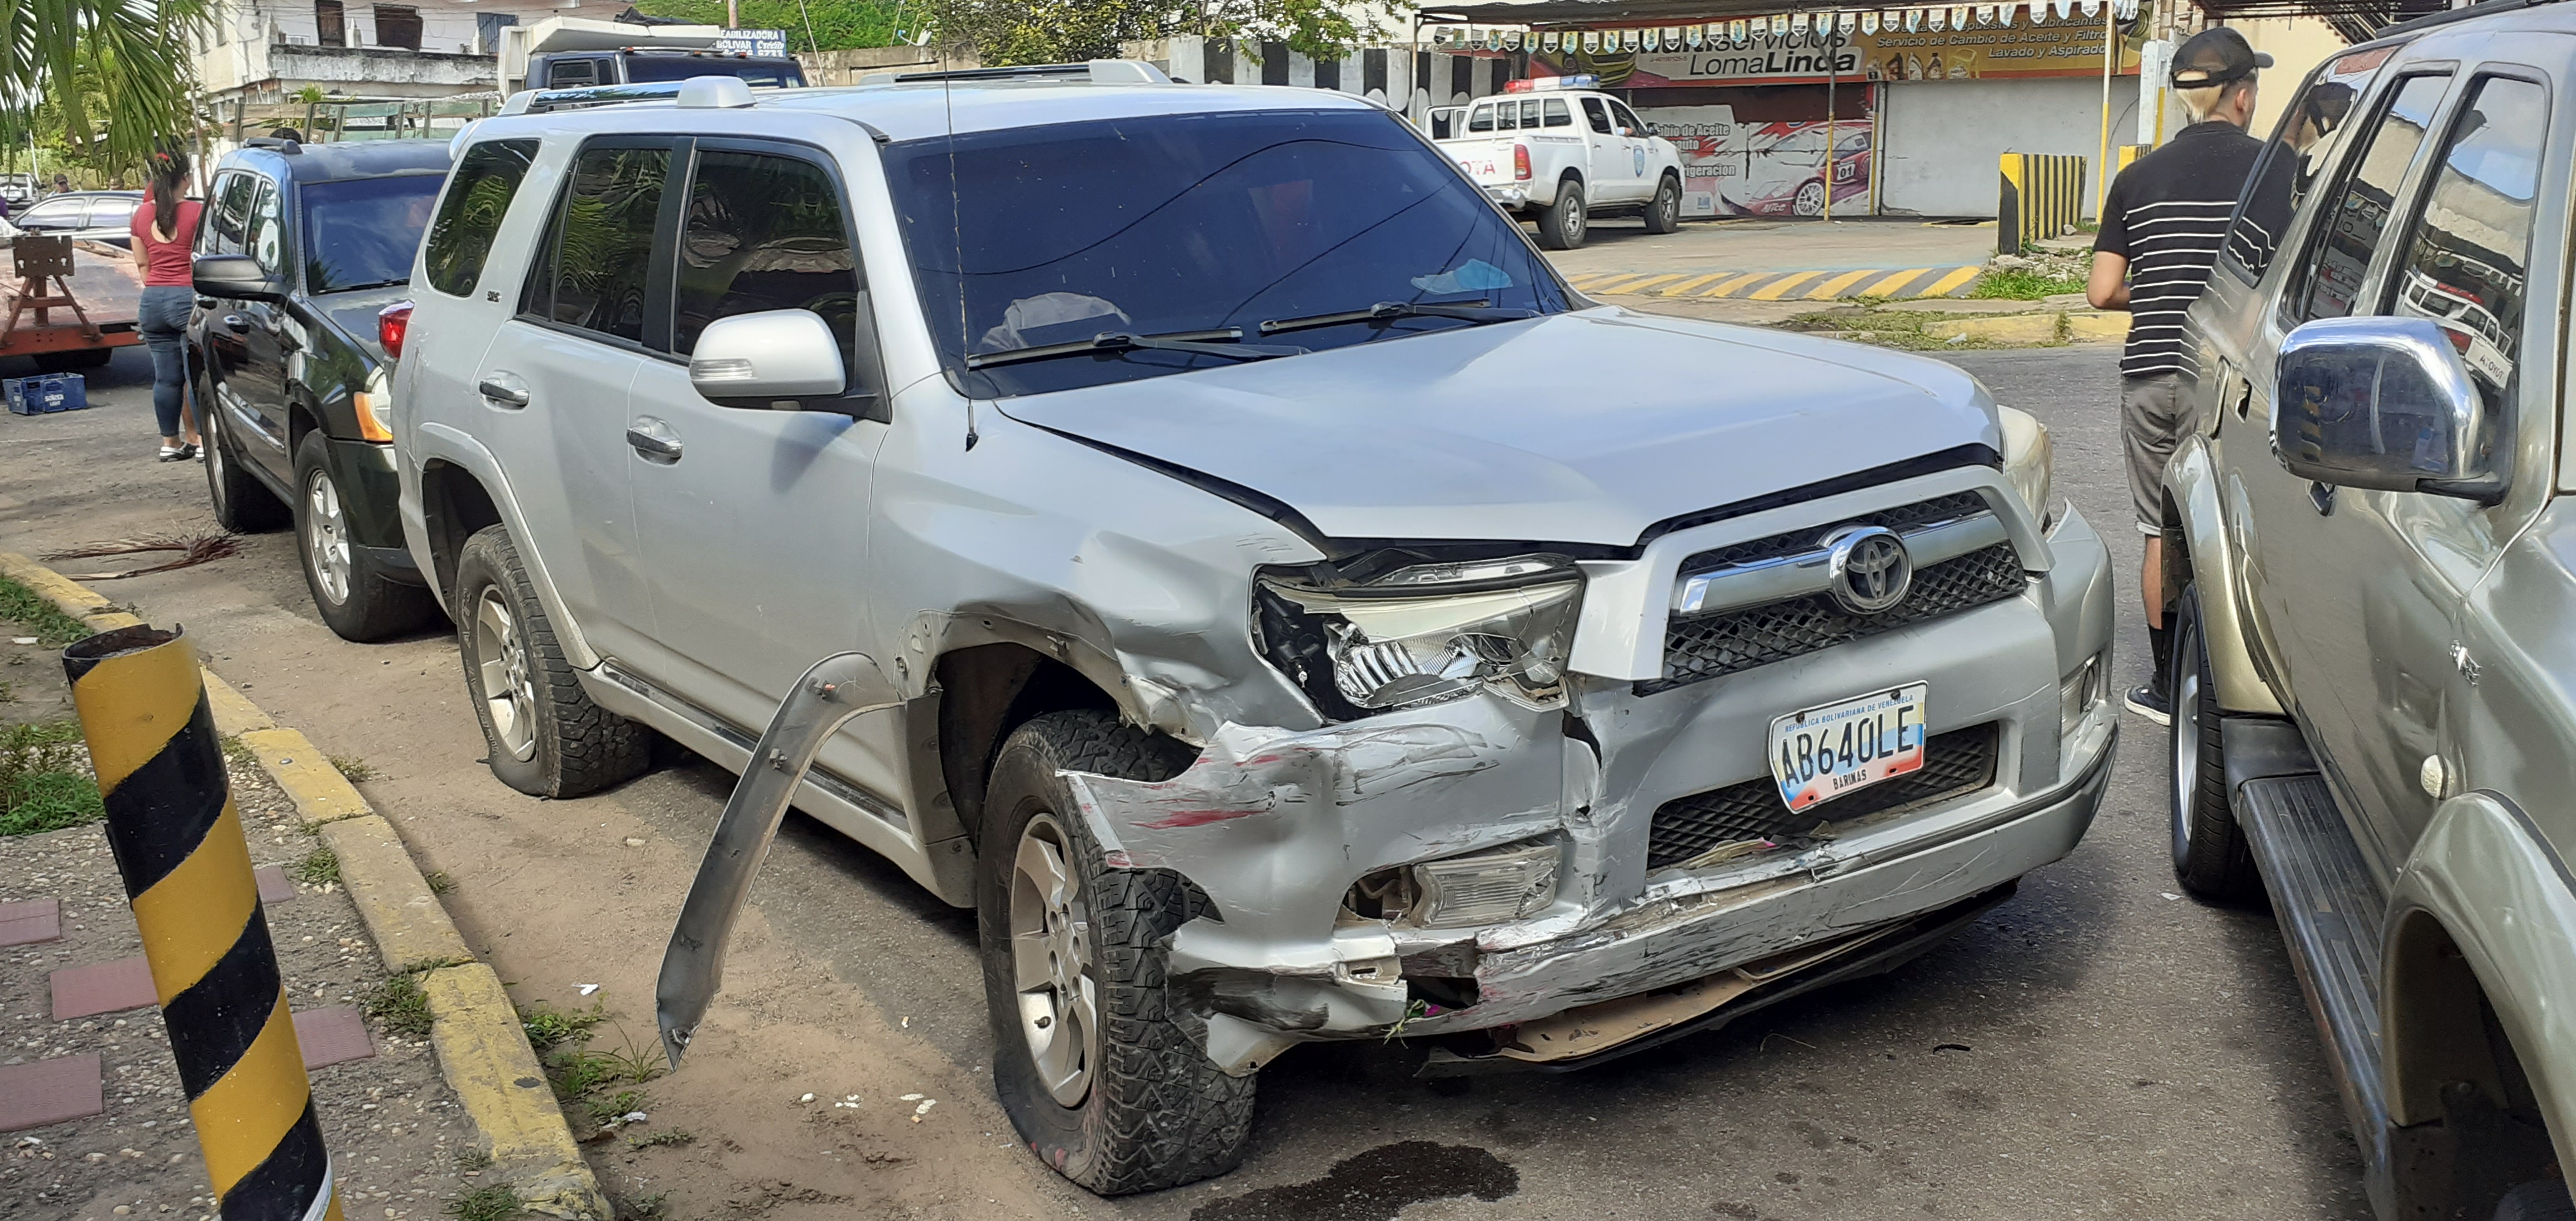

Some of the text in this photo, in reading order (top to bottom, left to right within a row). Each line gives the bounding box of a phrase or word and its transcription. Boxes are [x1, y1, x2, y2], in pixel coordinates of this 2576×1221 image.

[1877, 37, 1926, 47] Servicio
[1930, 36, 1945, 46] de
[1949, 34, 1996, 45] Cambio
[2000, 34, 2016, 44] de
[2019, 32, 2061, 43] Aceite
[2064, 34, 2072, 43] y
[1988, 47, 2034, 57] Lavado
[2037, 47, 2046, 58] y
[1682, 124, 1695, 135] de
[1697, 122, 1730, 135] Aceite
[1840, 165, 1852, 177] 01
[1822, 706, 1865, 723] BOLIVARIANA
[1867, 704, 1876, 712] DE
[1878, 694, 1913, 709] VENEZUELA
